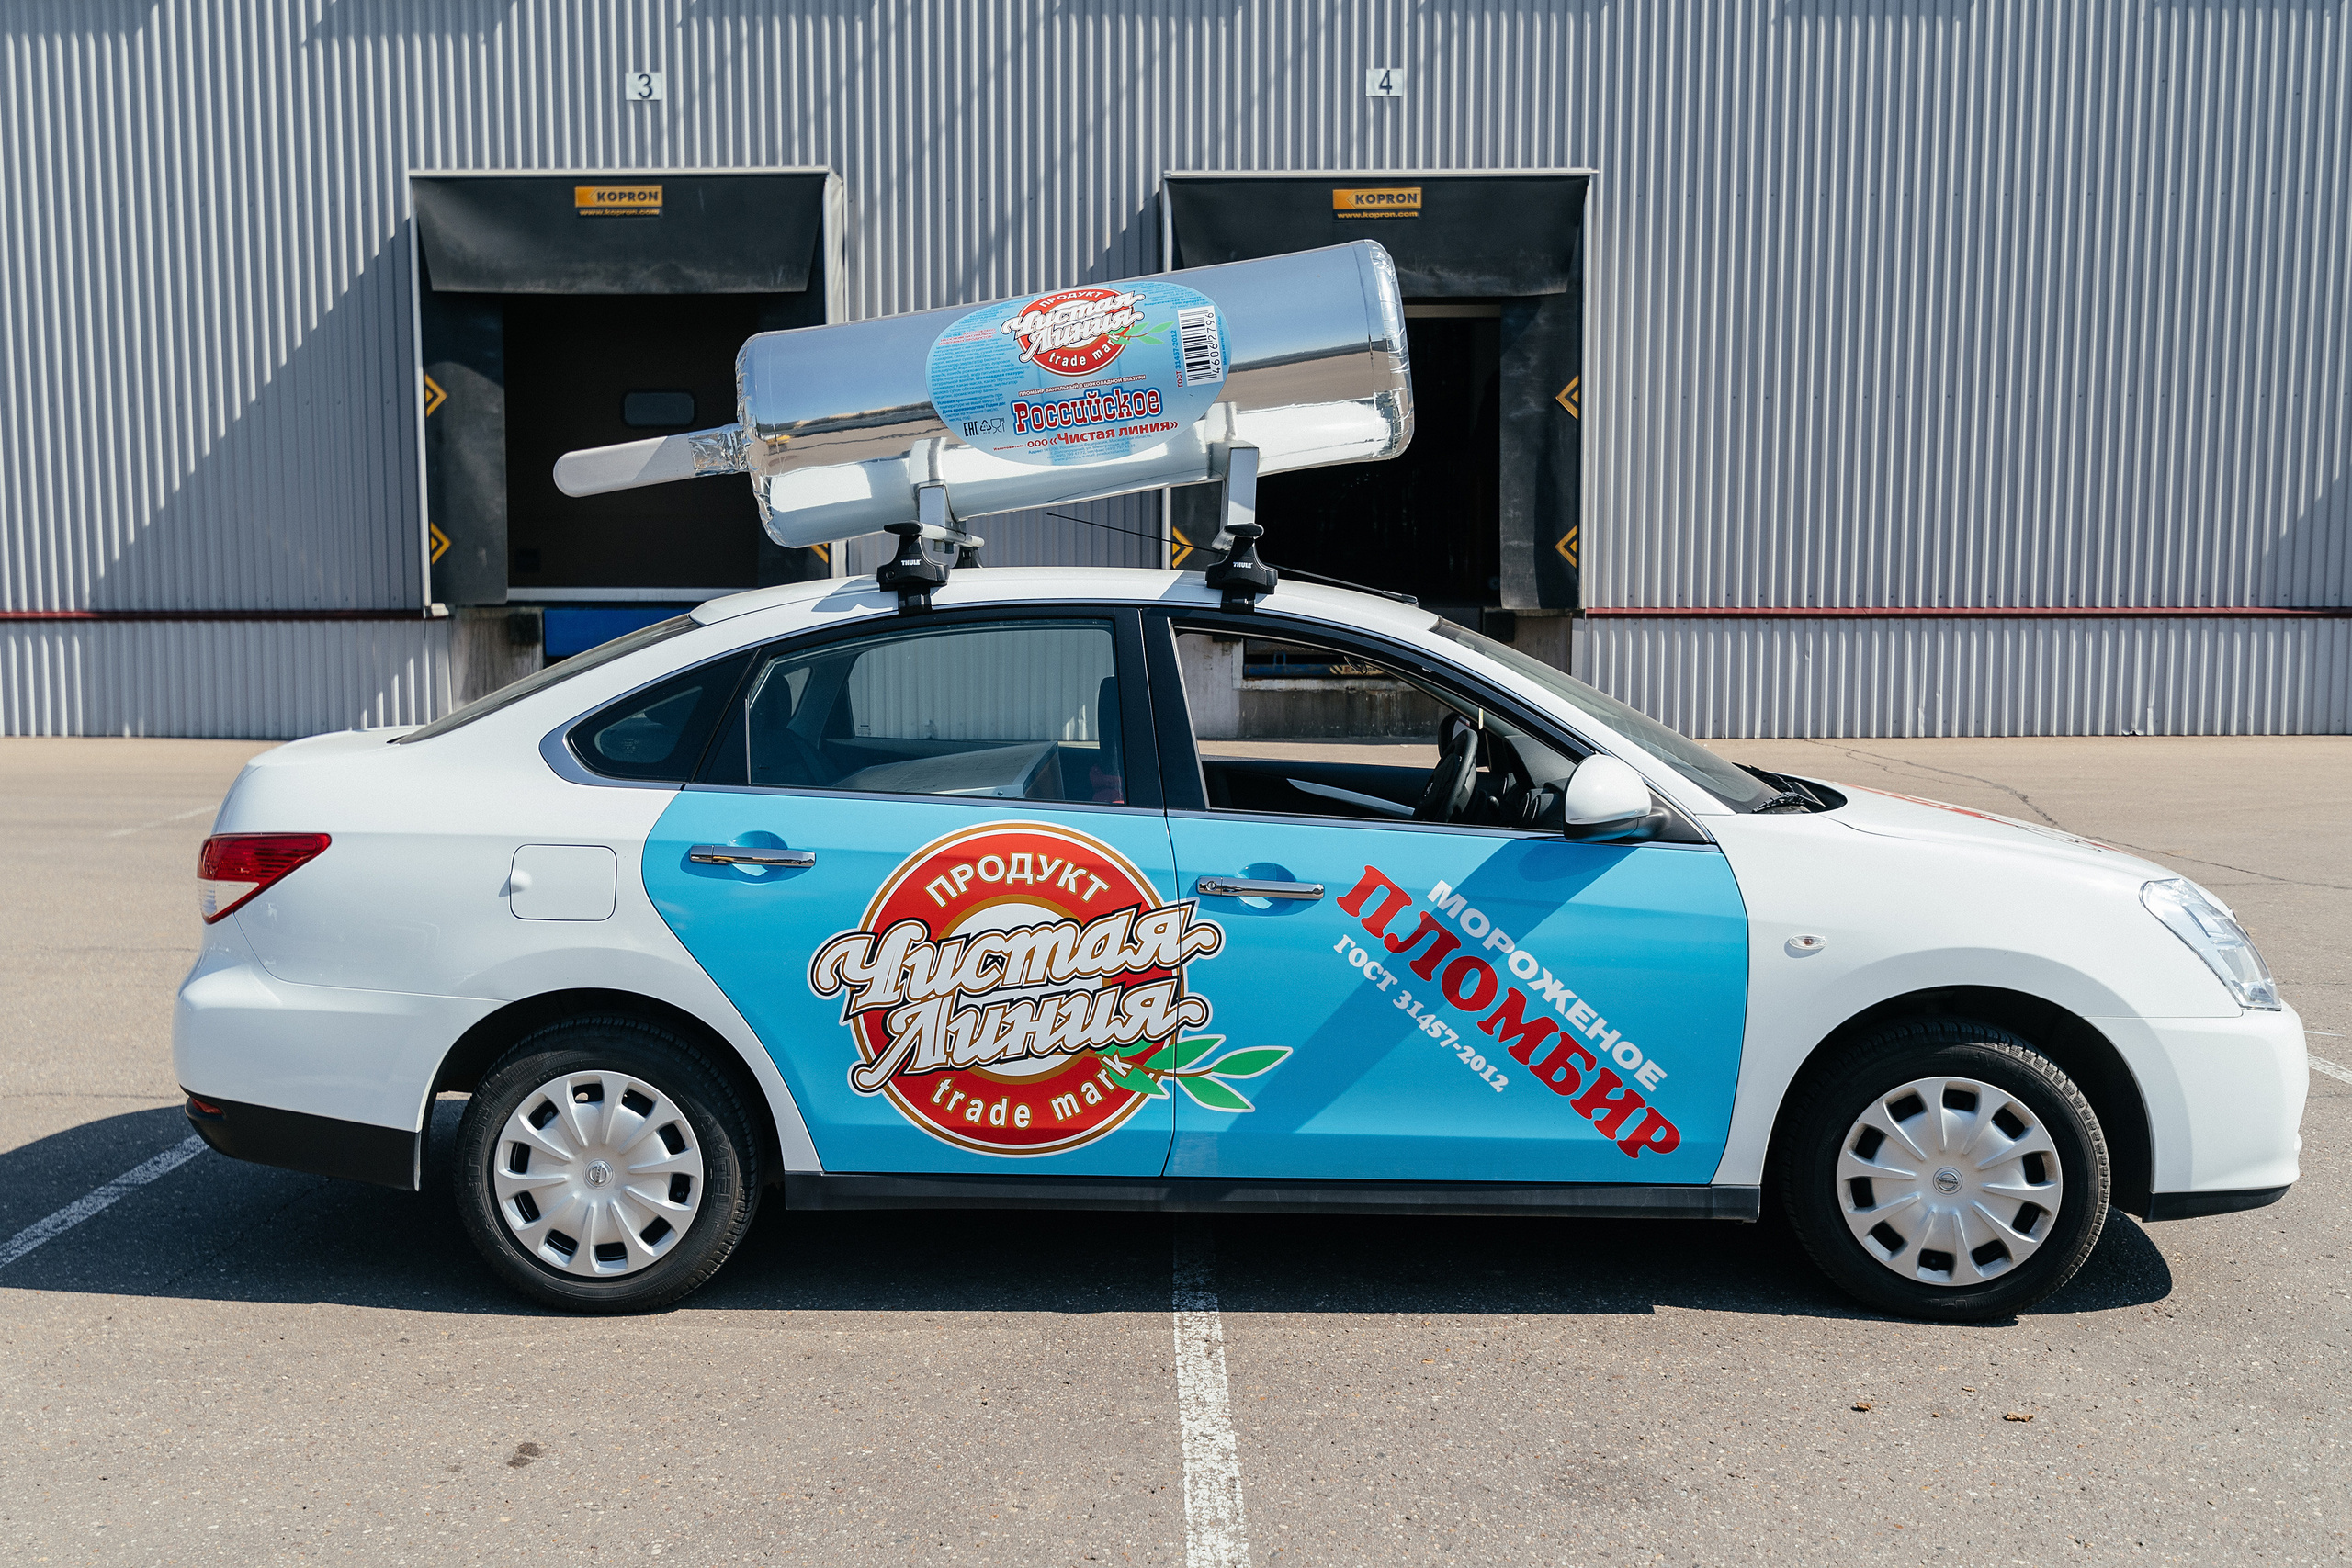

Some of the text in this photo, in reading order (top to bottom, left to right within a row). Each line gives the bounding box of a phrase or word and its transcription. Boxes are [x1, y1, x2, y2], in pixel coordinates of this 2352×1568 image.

[639, 73, 651, 98] 3
[1378, 70, 1393, 96] 4
[579, 208, 660, 216] www.kopron.com
[597, 191, 658, 201] KOPRON
[1355, 194, 1418, 204] KOPRON
[1001, 290, 1145, 339] Чистая
[1039, 290, 1104, 309] ПРОДУКТ
[1019, 309, 1145, 363] Линия
[1049, 333, 1120, 367] trade mark
[1170, 330, 1181, 369] 31457-2012
[1012, 388, 1161, 434] Российское
[1027, 439, 1048, 447] ООО
[1049, 428, 1116, 446] «Чистая
[1119, 421, 1178, 438] линия»
[922, 852, 1112, 908] ПРОДУКТ
[810, 901, 1224, 1015] Чистая
[1427, 879, 1668, 1092] МОРОЖЕНОЕ
[850, 977, 1211, 1092] Линия
[1333, 933, 1510, 1093] ГОСТ 31457-2012
[1336, 864, 1681, 1159] ПЛОМБИР
[931, 1052, 1135, 1130] trade mark
